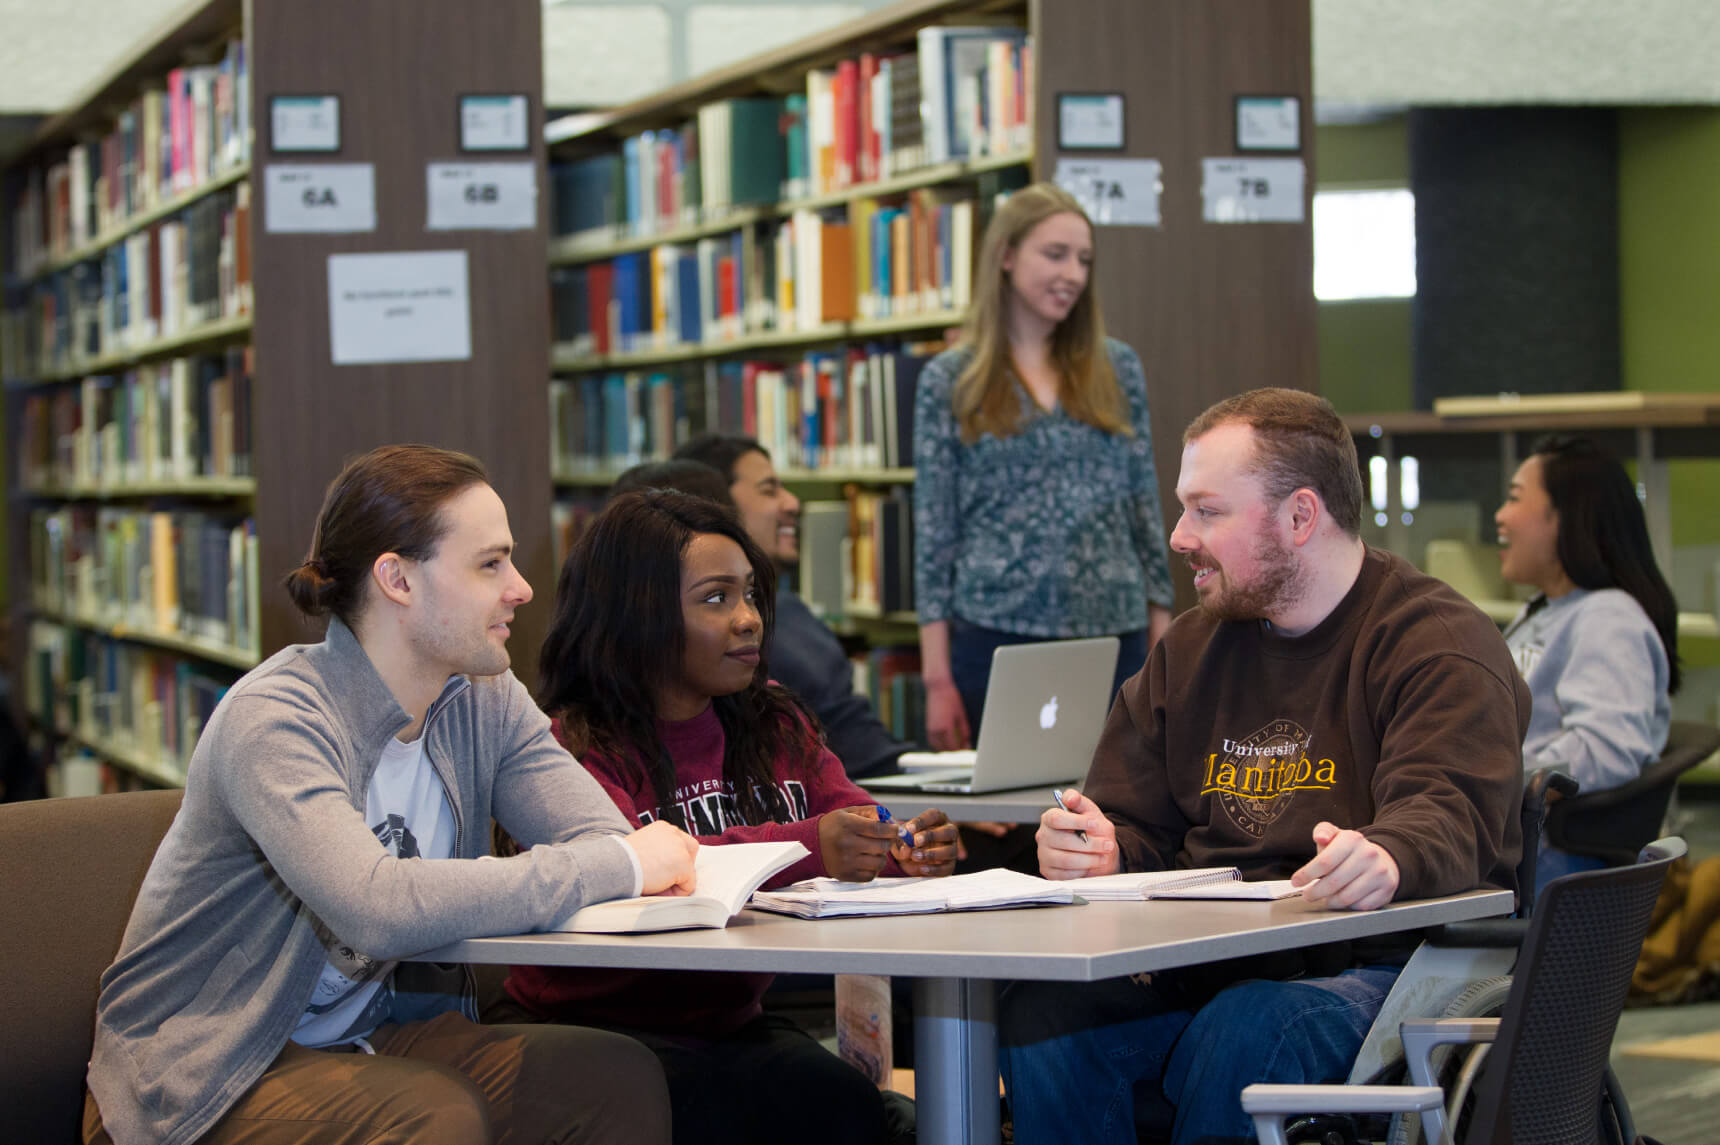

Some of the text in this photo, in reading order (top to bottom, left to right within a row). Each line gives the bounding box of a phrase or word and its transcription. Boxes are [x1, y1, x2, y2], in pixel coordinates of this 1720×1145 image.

[464, 184, 499, 204] 6B
[1092, 180, 1125, 199] 7A
[1237, 178, 1270, 197] 7B
[302, 187, 337, 208] 6A
[1223, 738, 1299, 756] Universiy
